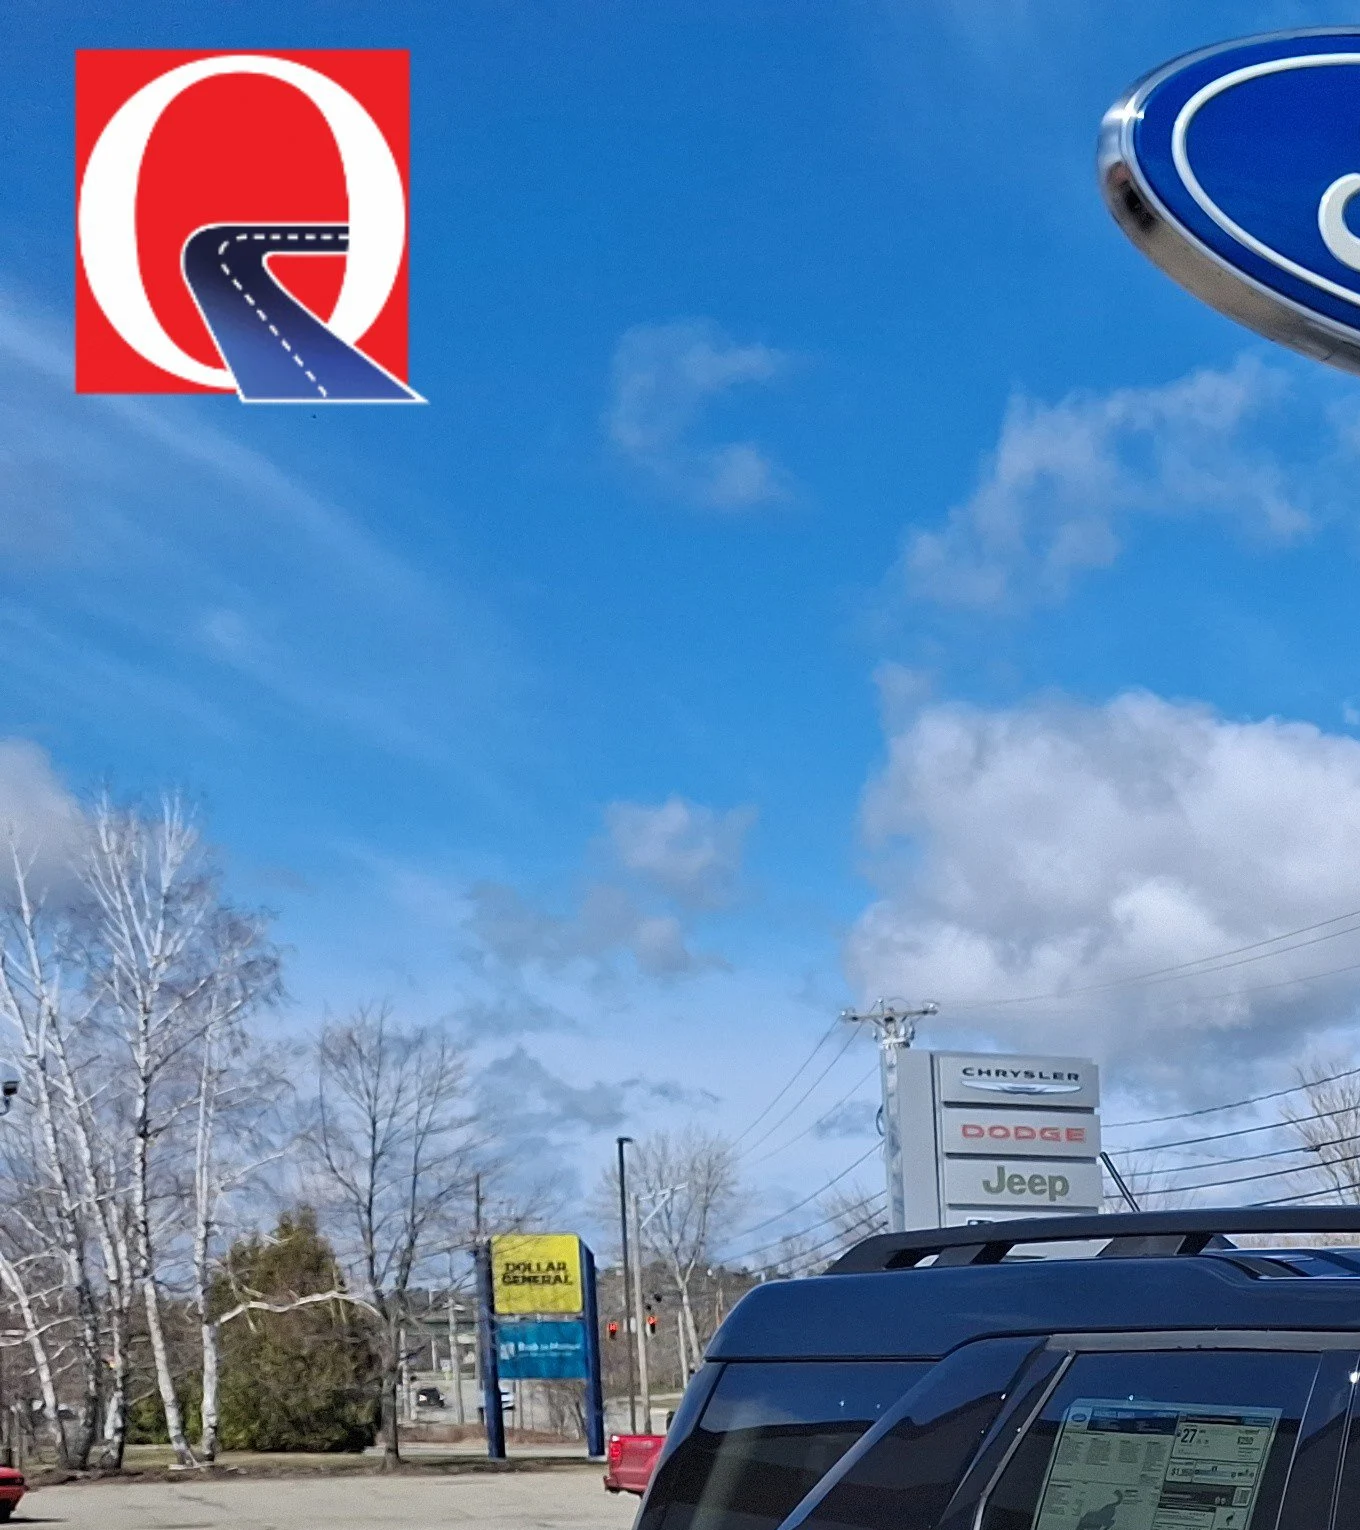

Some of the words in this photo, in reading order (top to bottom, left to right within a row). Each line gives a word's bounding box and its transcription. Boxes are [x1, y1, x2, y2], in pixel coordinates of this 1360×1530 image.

[961, 1066, 1080, 1082] CHRYSLER
[960, 1124, 1087, 1143] DODGE
[981, 1165, 1070, 1202] Jeep
[504, 1261, 568, 1273] DOLLAR
[501, 1272, 574, 1286] GENERAL
[1180, 1428, 1198, 1444] 27
